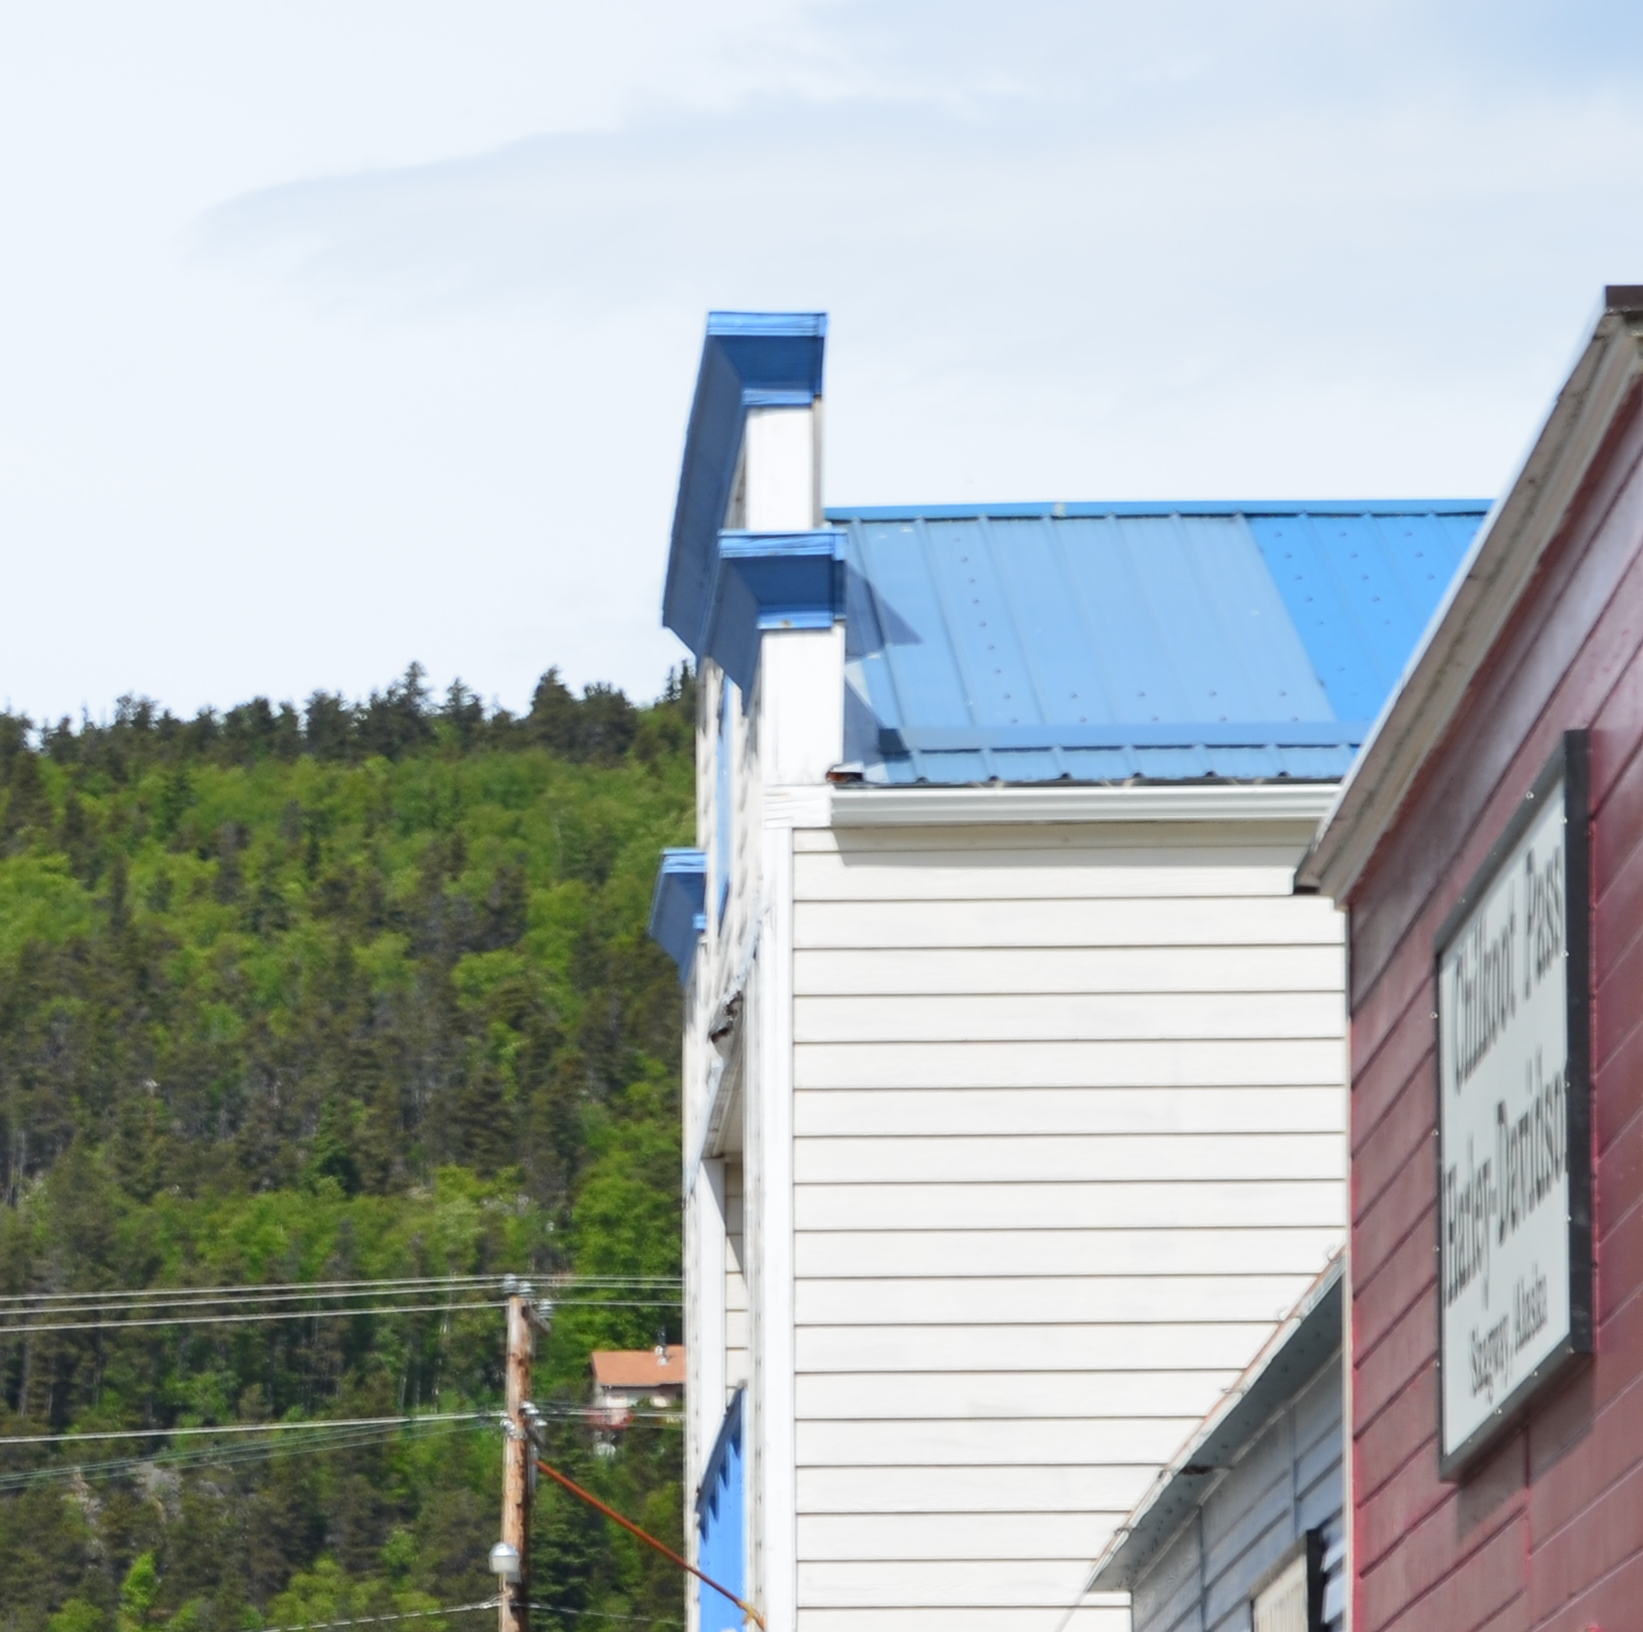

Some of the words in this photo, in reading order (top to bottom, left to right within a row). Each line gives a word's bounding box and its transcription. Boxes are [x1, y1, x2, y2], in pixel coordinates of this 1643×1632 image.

[1452, 880, 1517, 1096] Chilkoot
[1524, 845, 1565, 1001] Pass
[1441, 1042, 1566, 1311] Harley-Davidso
[1514, 1260, 1548, 1356] Alaska
